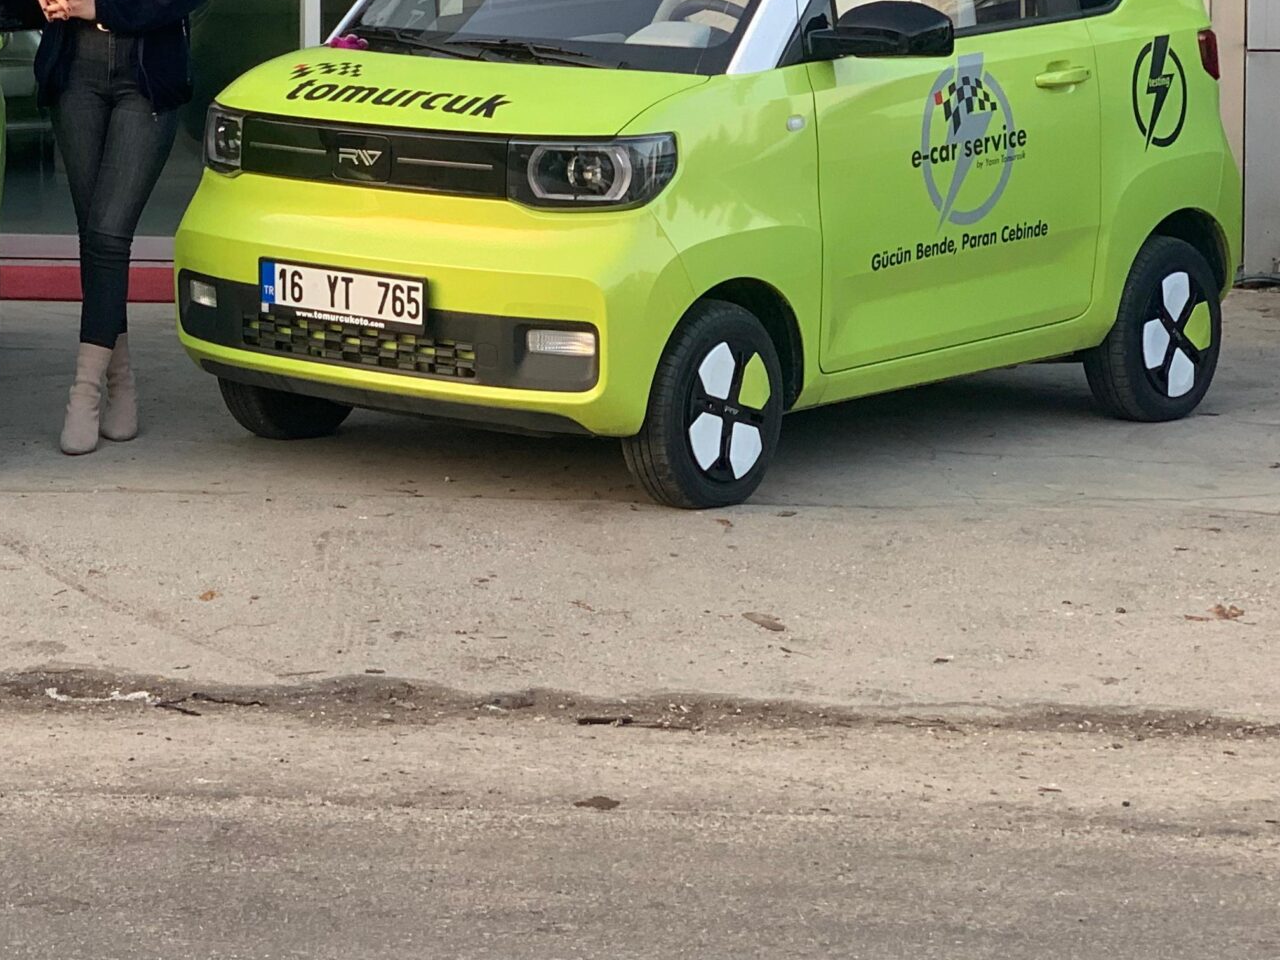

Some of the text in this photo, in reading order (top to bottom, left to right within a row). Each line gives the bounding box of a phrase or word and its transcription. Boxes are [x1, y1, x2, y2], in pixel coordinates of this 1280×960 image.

[286, 79, 512, 118] tomurcuk
[911, 124, 1027, 168] e-car service
[871, 220, 1049, 271] Gücün Bende, Paran Cebinde
[264, 285, 275, 295] TR
[278, 268, 420, 320] 16 YT 765
[295, 310, 385, 329] www.tomurcukoto.com
